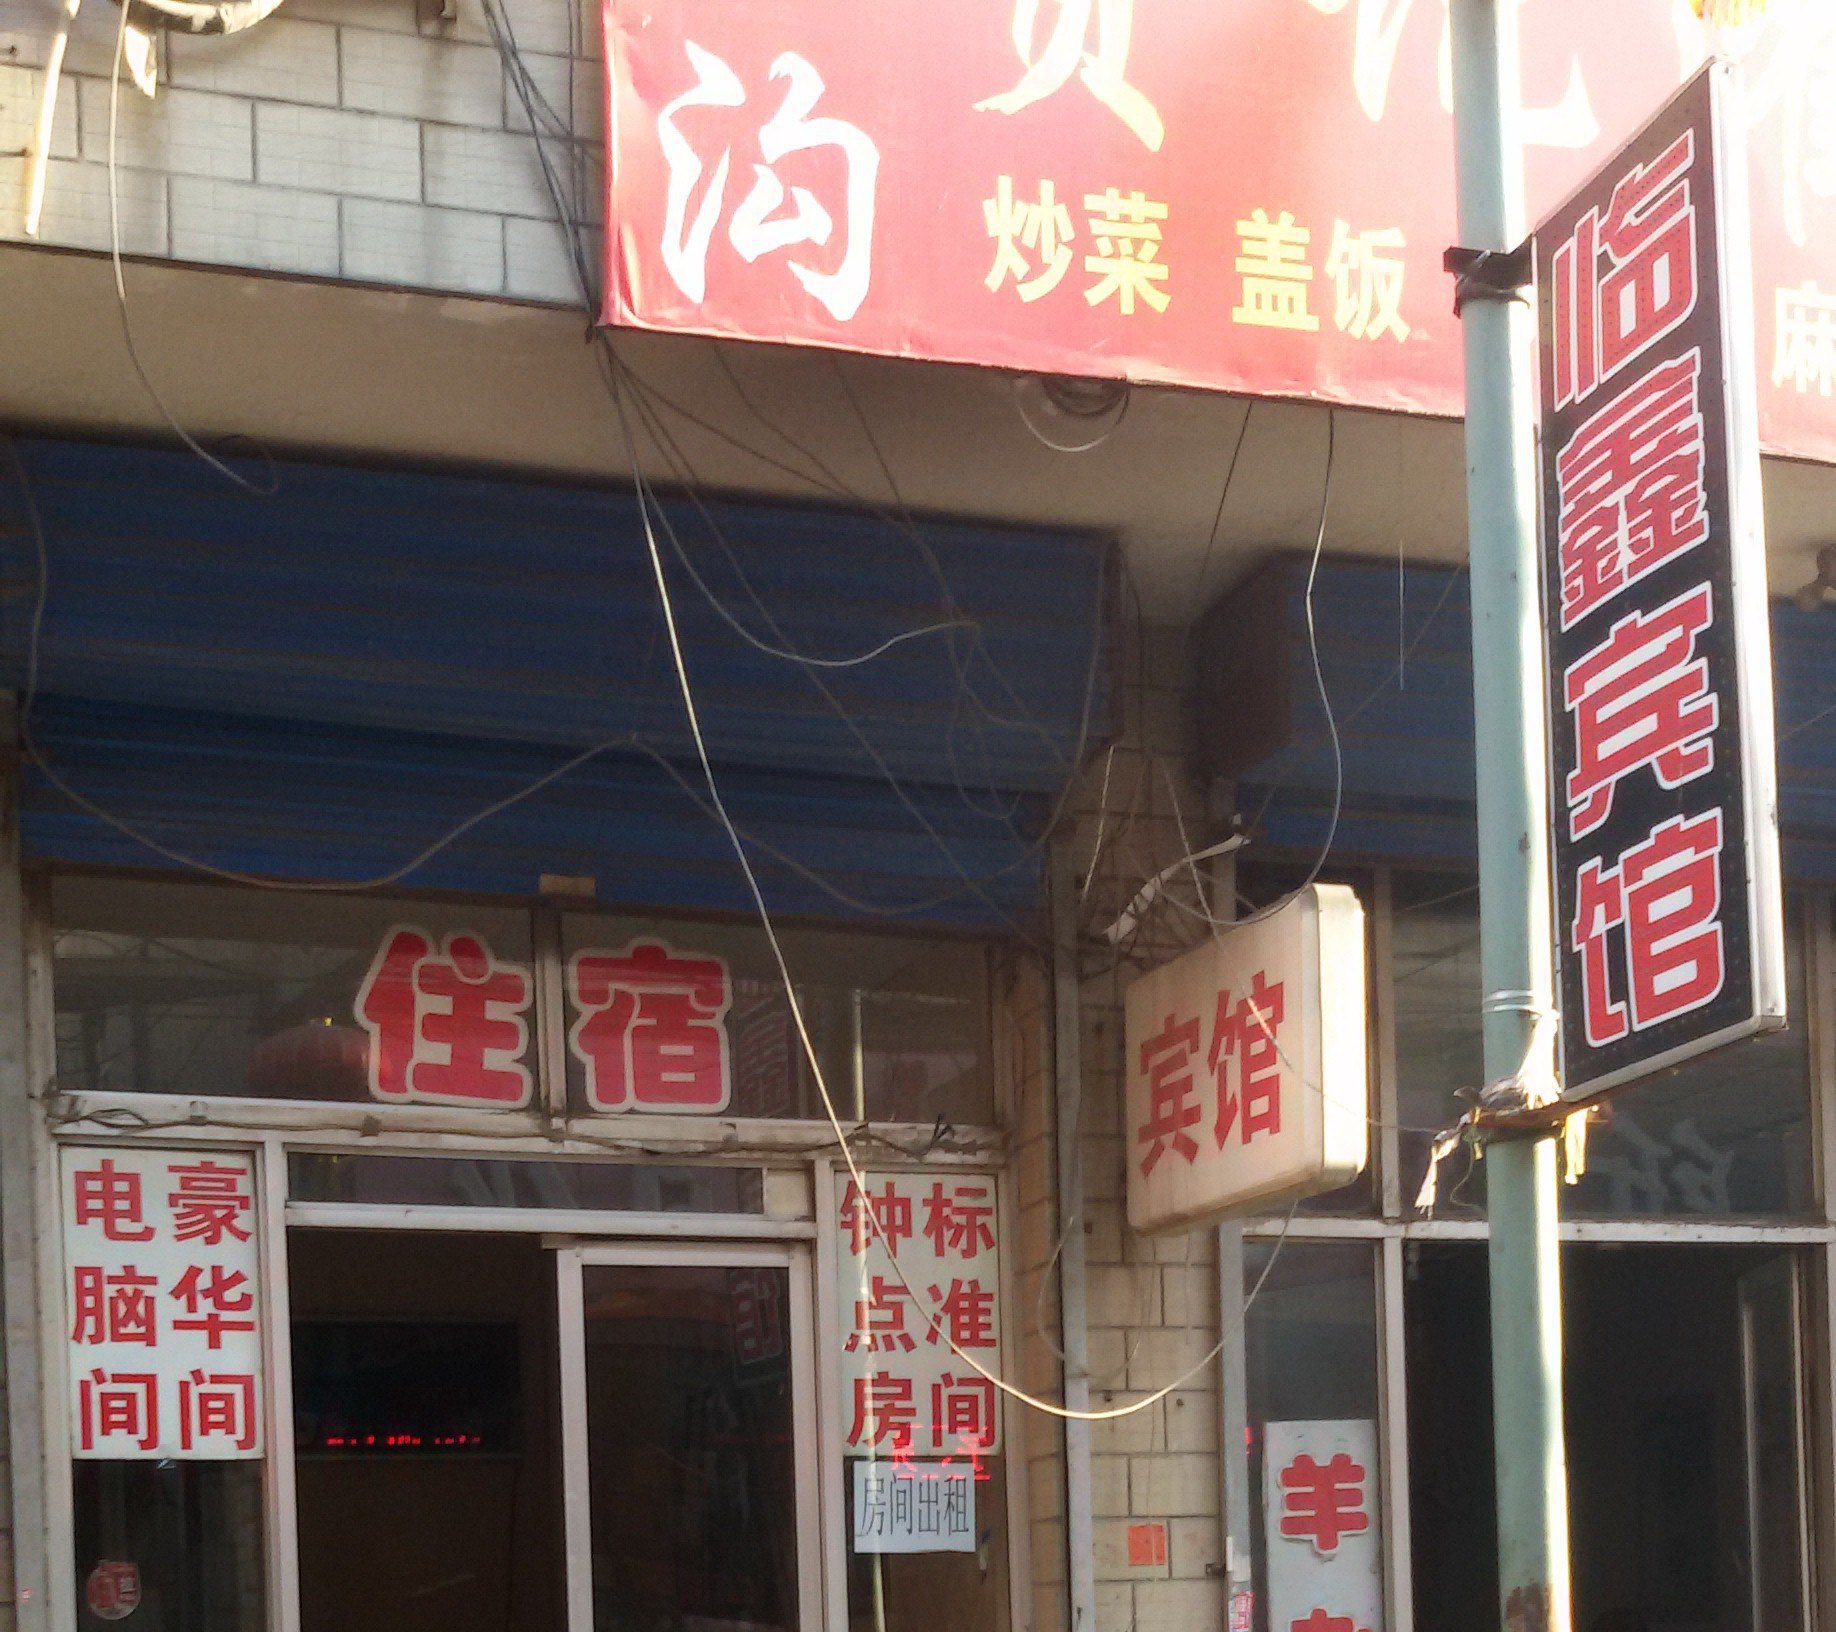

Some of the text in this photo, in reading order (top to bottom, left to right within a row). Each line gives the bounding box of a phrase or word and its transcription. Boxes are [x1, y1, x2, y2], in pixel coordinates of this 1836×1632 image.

[982, 174, 1171, 314] 炒菜
[1231, 208, 1410, 342] 盖饭
[1552, 128, 1724, 1047] 临鑫宾馆
[357, 927, 730, 1113] 住宿
[1137, 970, 1284, 1177] 宾馆
[71, 1158, 157, 1451] 电脑间
[167, 1160, 257, 1451] 豪华间
[839, 1179, 917, 1448] 钟点房
[923, 1181, 997, 1448] 标准间
[858, 1473, 970, 1537] 房间出租
